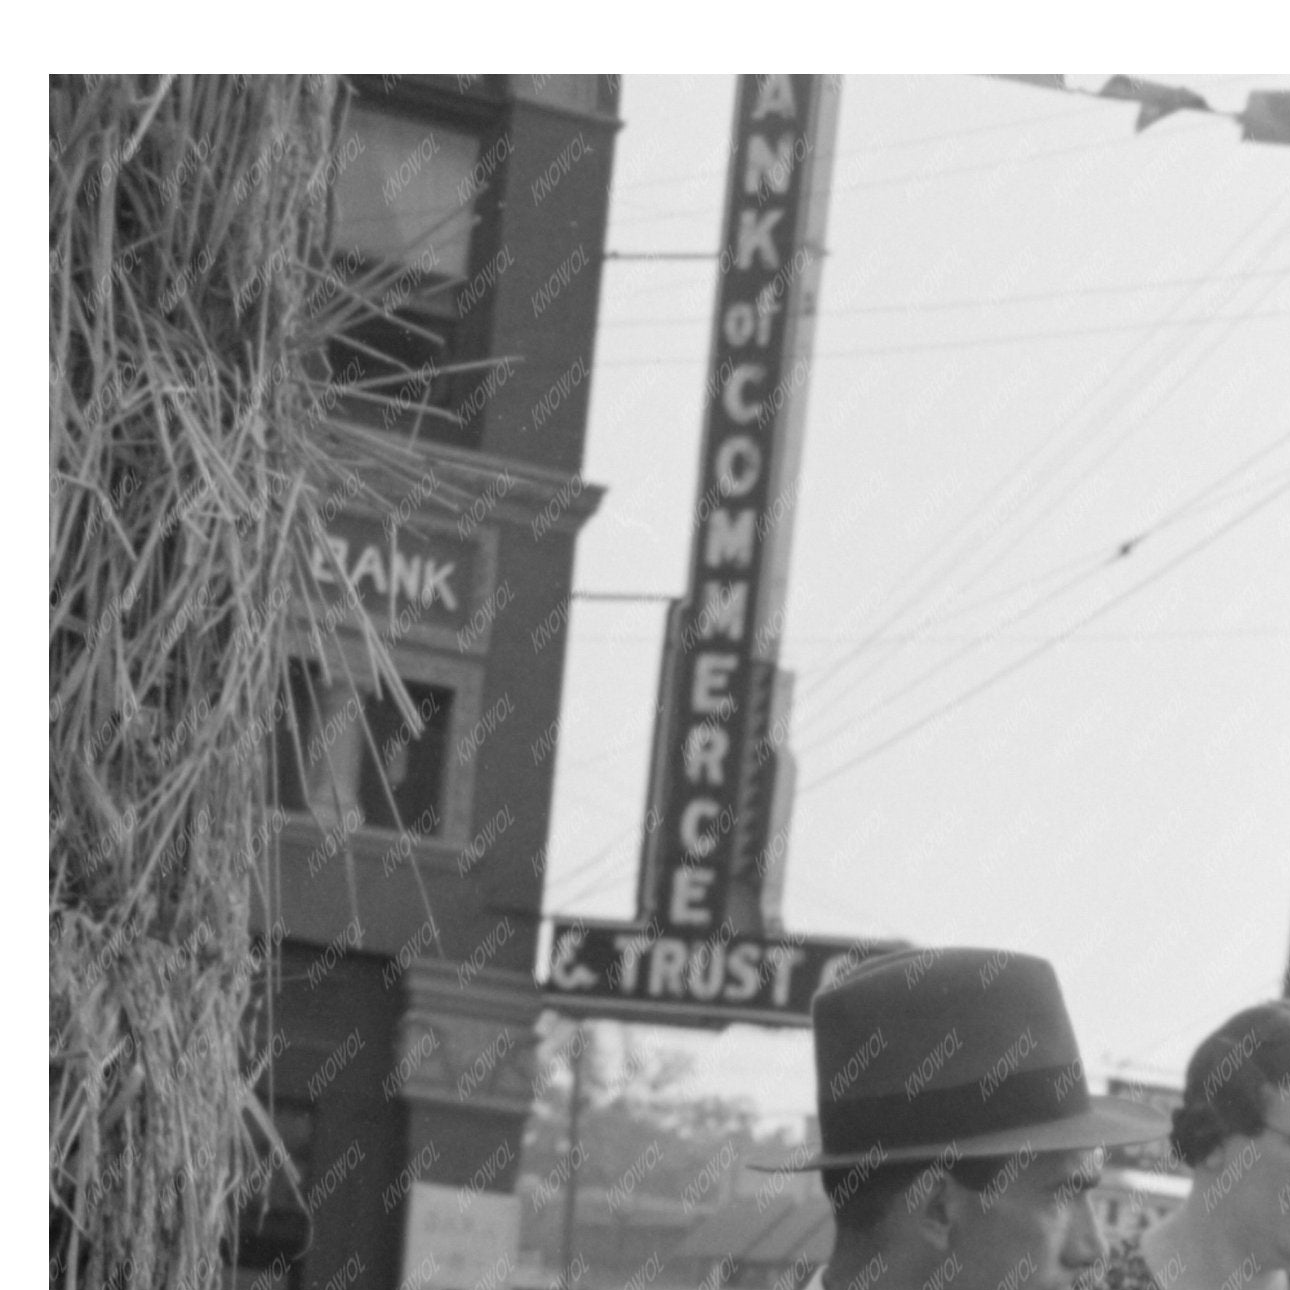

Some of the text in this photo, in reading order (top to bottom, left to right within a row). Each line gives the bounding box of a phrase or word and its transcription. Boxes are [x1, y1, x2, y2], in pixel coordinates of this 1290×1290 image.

[724, 286, 782, 348] of
[312, 536, 458, 612] BANK
[670, 364, 767, 924] COMMERCE
[614, 936, 806, 1006] TRUST
